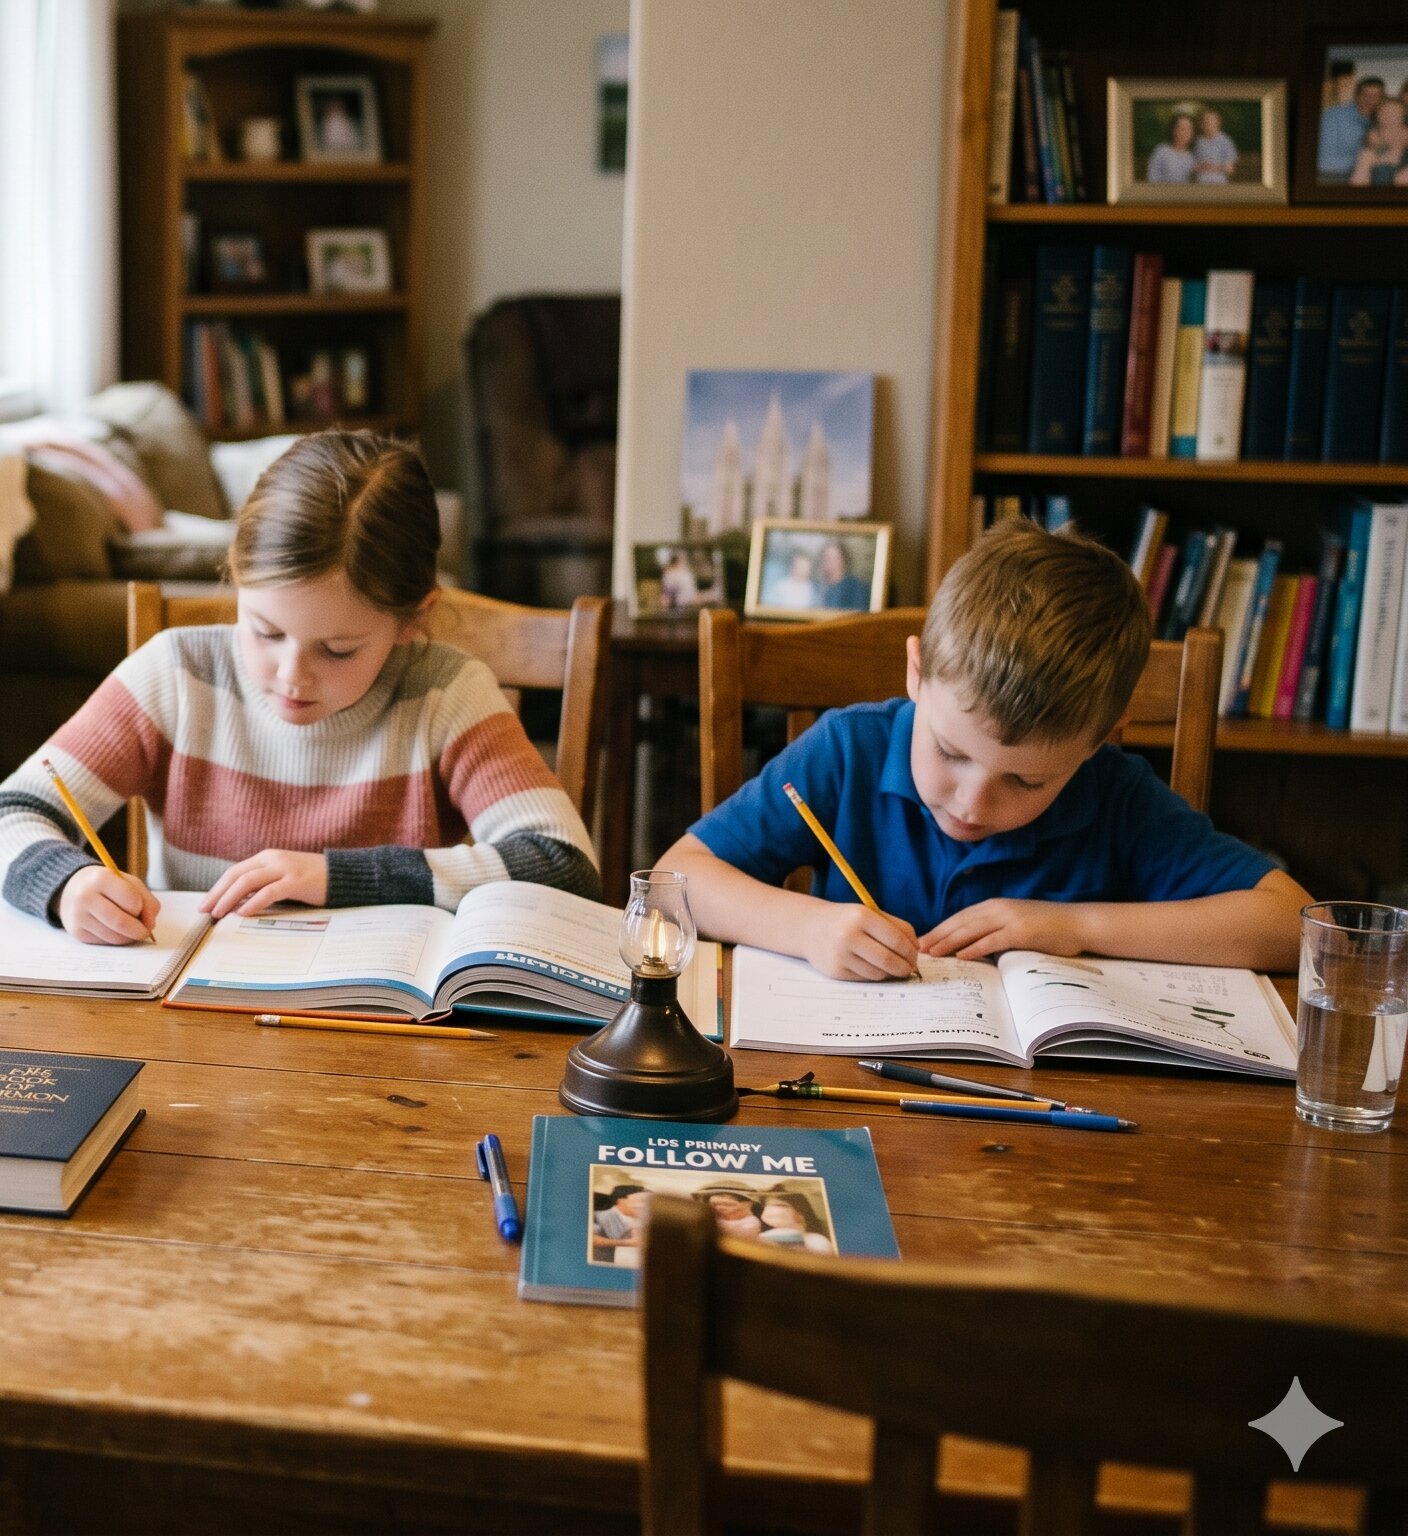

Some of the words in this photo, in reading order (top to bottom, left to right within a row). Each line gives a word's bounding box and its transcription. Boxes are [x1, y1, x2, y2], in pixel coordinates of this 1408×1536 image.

[5, 1083, 35, 1091] OF
[648, 1137, 680, 1148] LDS
[684, 1140, 762, 1152] PRIMARY
[597, 1144, 749, 1169] FOLLOW
[761, 1154, 818, 1174] ME
